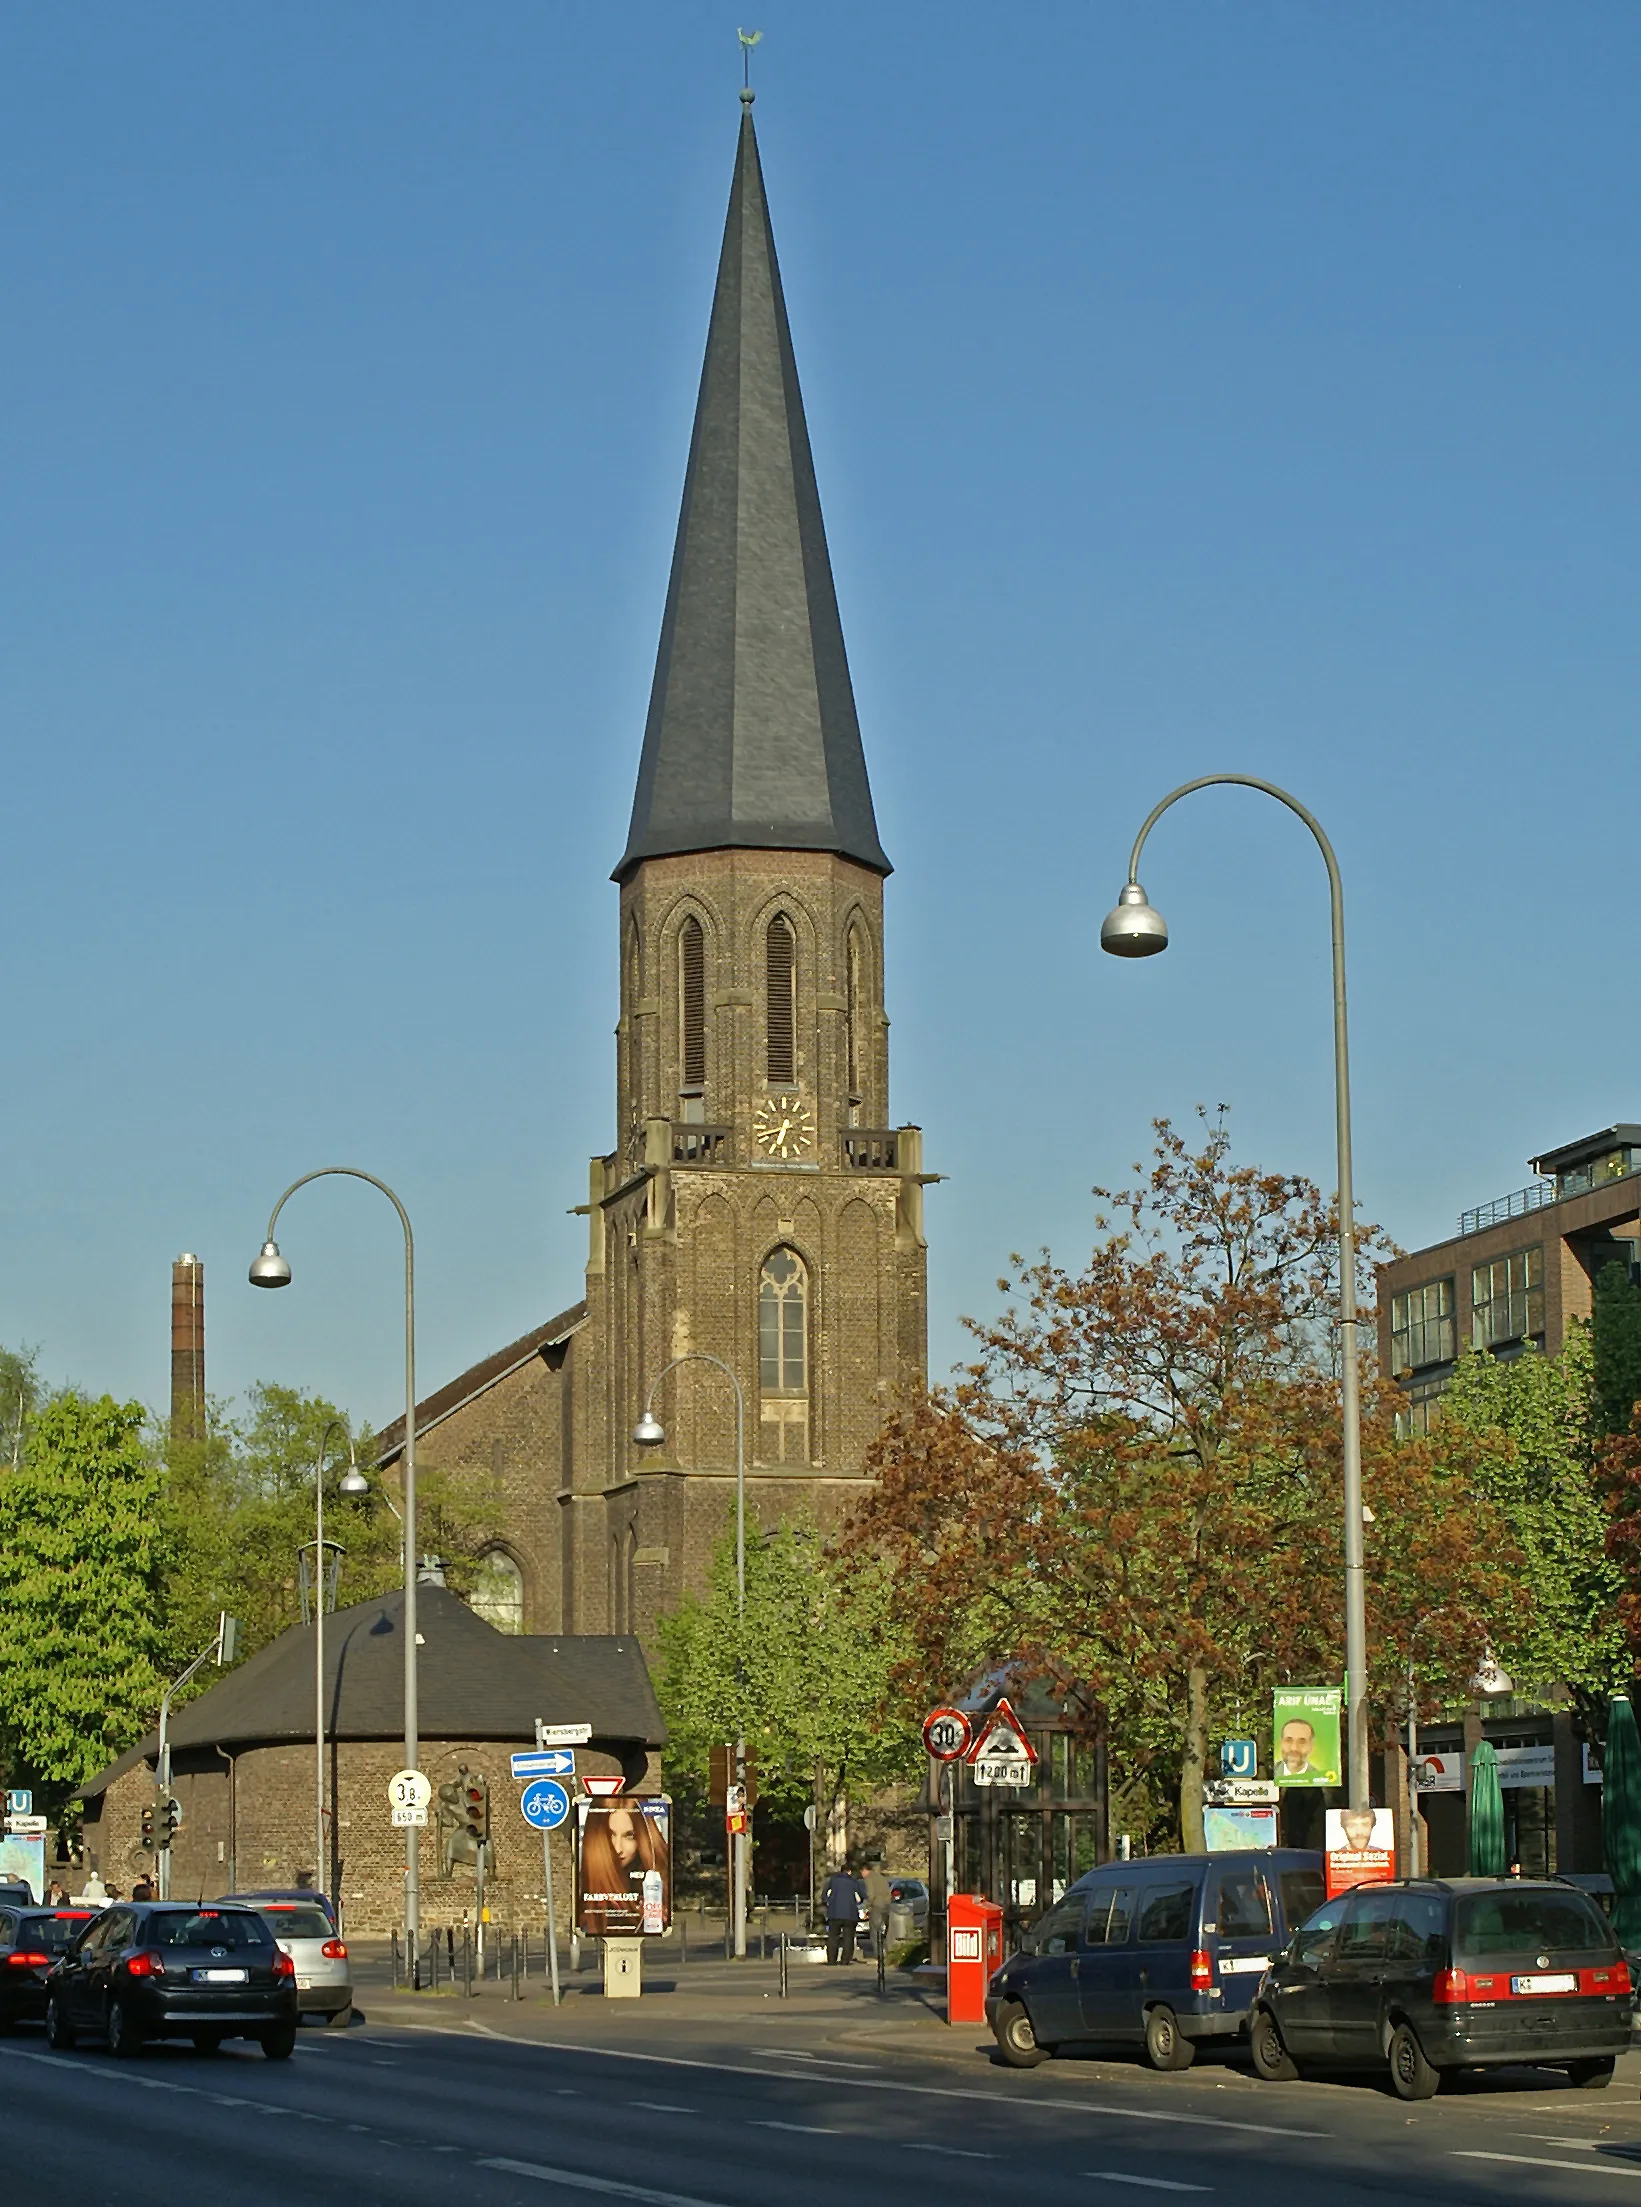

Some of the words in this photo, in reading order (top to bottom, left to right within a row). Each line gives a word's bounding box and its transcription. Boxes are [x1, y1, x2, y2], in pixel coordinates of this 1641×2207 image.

[932, 1722, 955, 1747] 30
[986, 1765, 1007, 1778] 200
[1228, 1745, 1250, 1773] U
[12, 1792, 27, 1811] U
[954, 1932, 978, 1957] Bild
